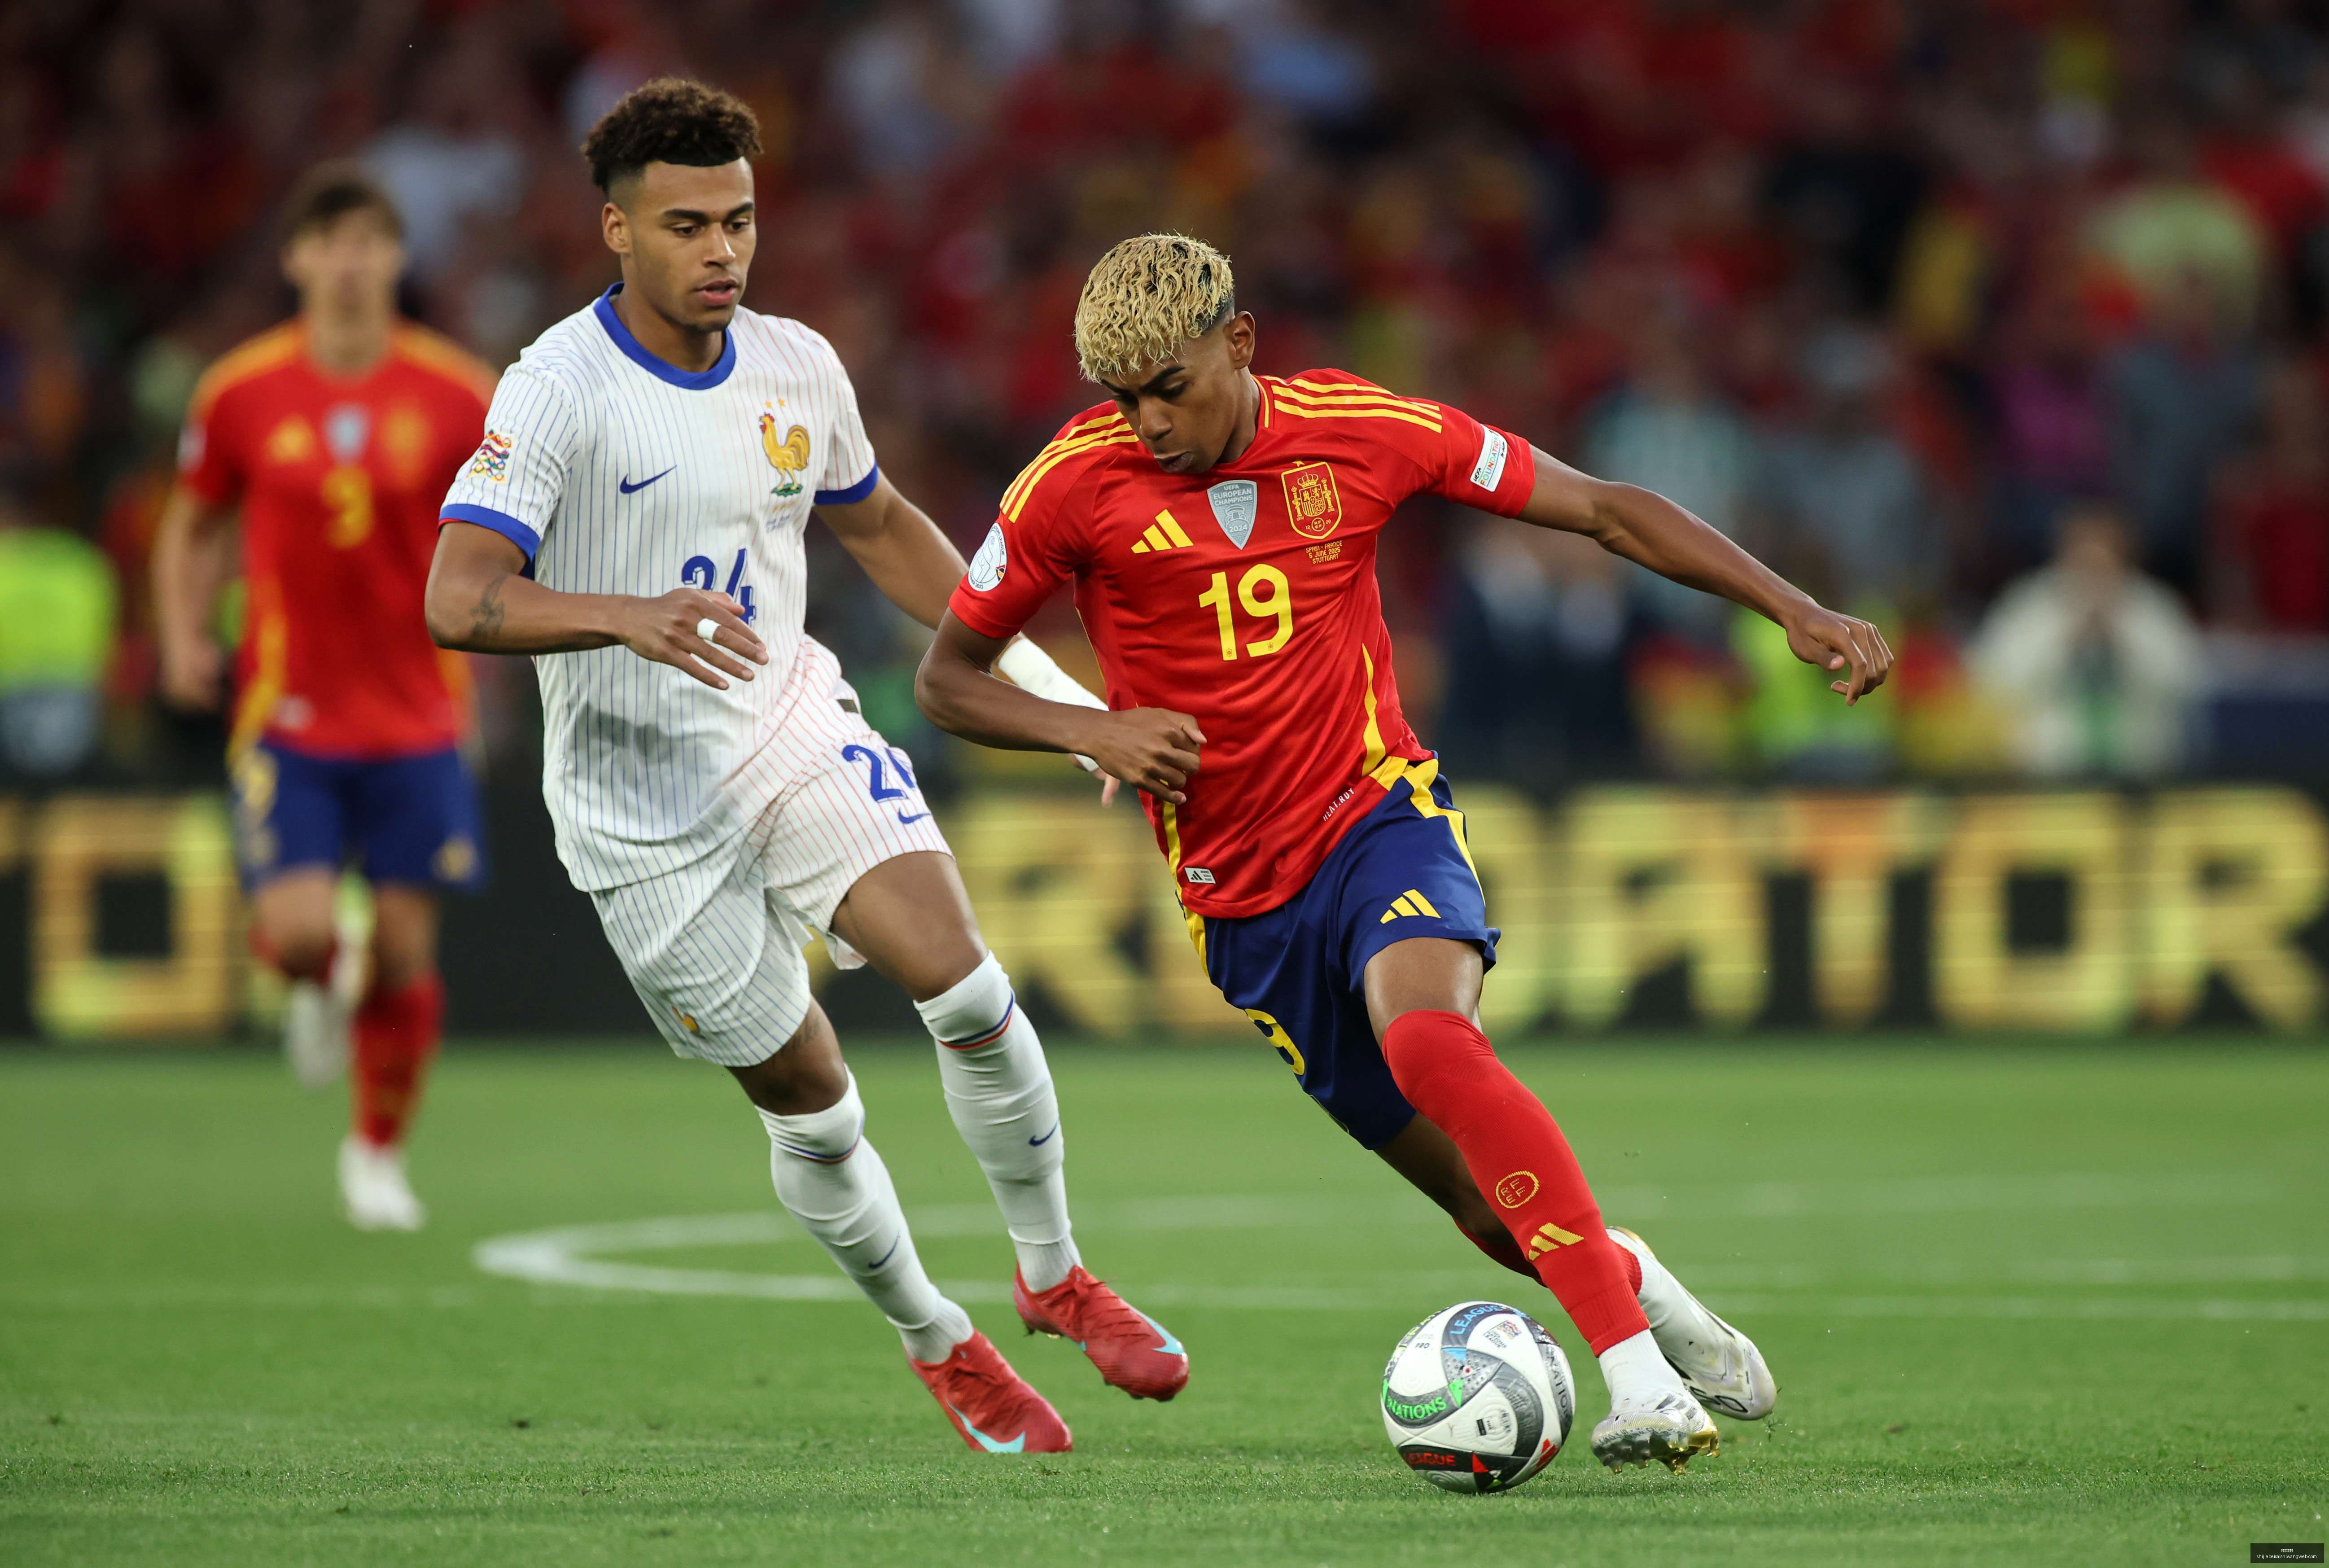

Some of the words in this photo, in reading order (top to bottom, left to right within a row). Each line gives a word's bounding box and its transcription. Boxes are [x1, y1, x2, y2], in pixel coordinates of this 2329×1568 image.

[1480, 437, 1500, 486] FOUNDATION
[1473, 467, 1482, 482] UEFA
[1213, 488, 1252, 500] EUROPEAN
[1214, 495, 1253, 506] CHAMPIONS
[1229, 525, 1248, 533] 2024
[1305, 545, 1320, 553] SPAIN
[1324, 540, 1343, 550] FRANCE
[1328, 547, 1341, 555] 2025
[1312, 553, 1339, 564] STUTTGART
[1199, 564, 1293, 661] 19
[1322, 788, 1355, 821] HEAT.RDY
[1450, 1305, 1503, 1335] LEAGUE
[1387, 1396, 1447, 1419] NATIONS
